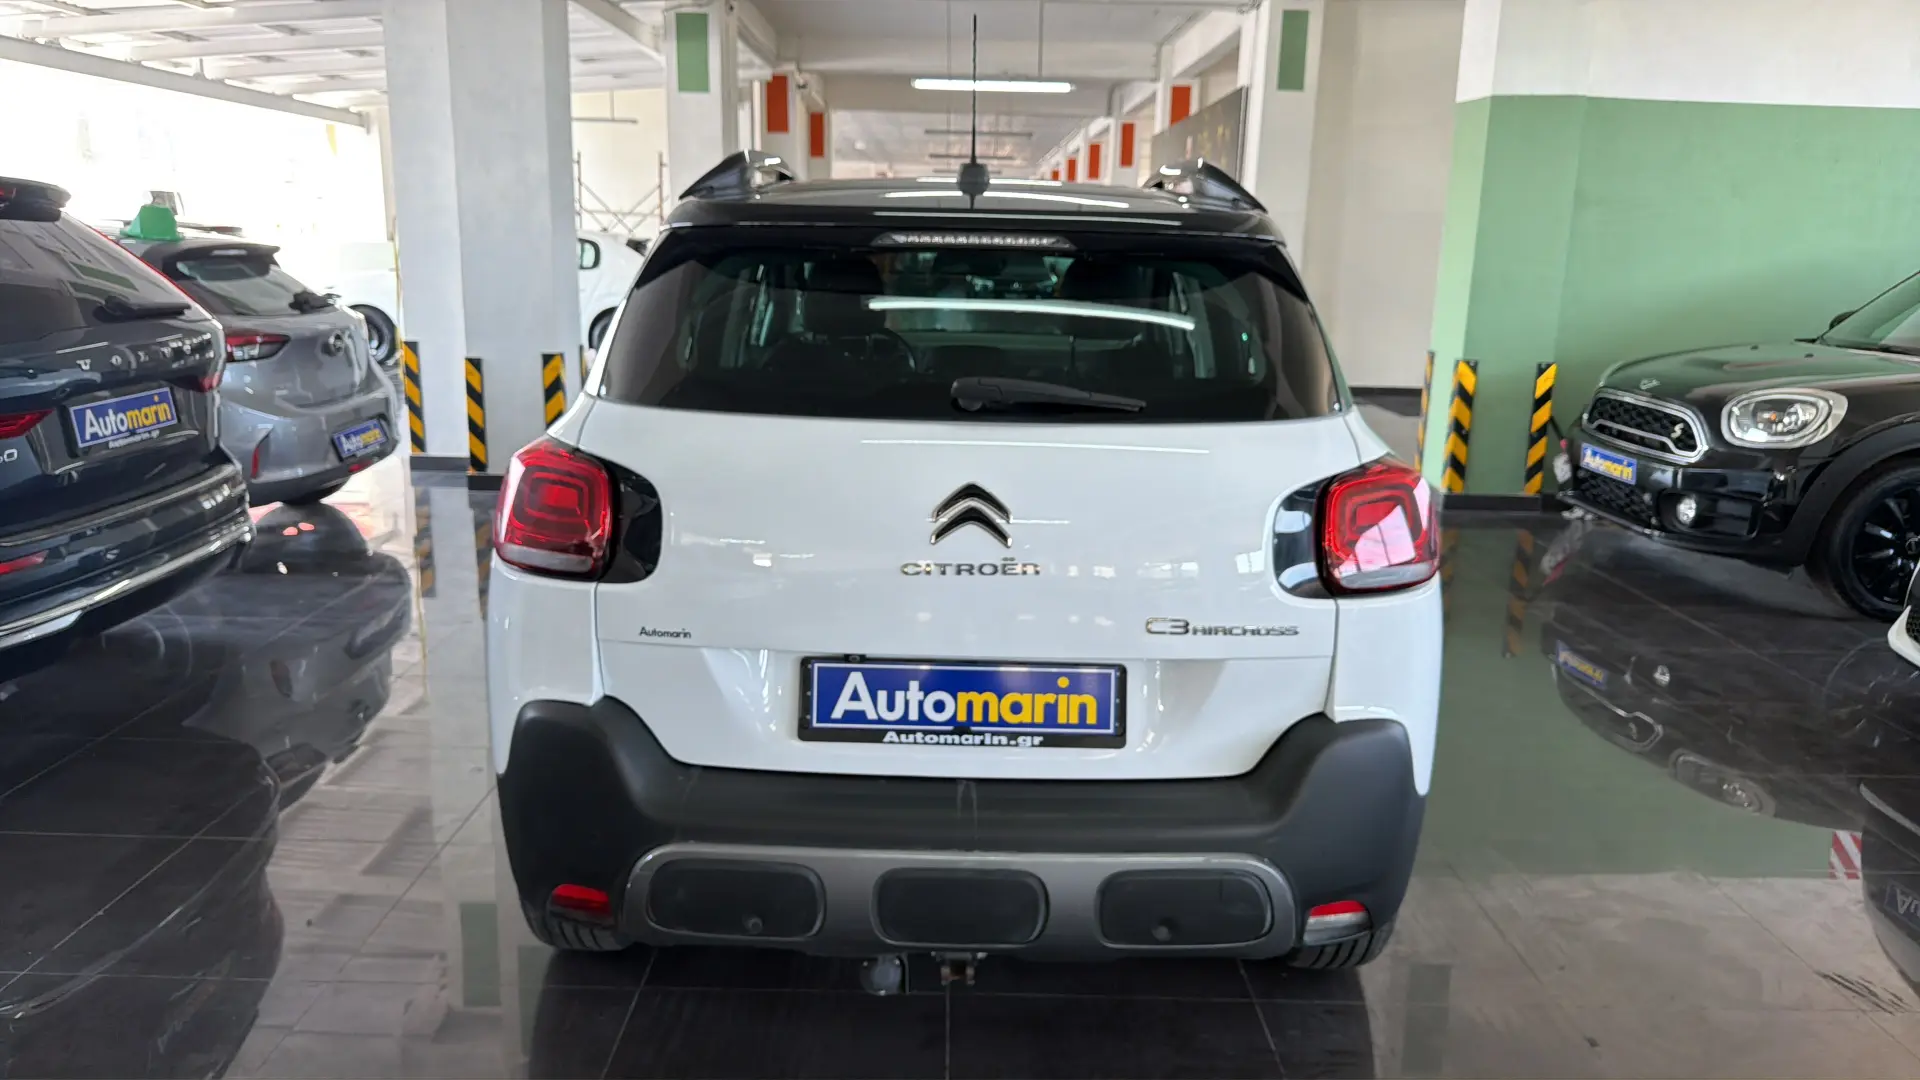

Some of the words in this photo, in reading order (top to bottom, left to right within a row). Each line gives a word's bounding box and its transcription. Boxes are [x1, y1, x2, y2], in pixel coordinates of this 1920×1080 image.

[84, 395, 172, 440] Automarin
[639, 626, 692, 639] Automarin
[1145, 617, 1189, 635] C3
[1192, 625, 1300, 636] AIRCROSS
[830, 670, 1098, 725] Automarin
[882, 729, 1044, 748] Automarin.gr
